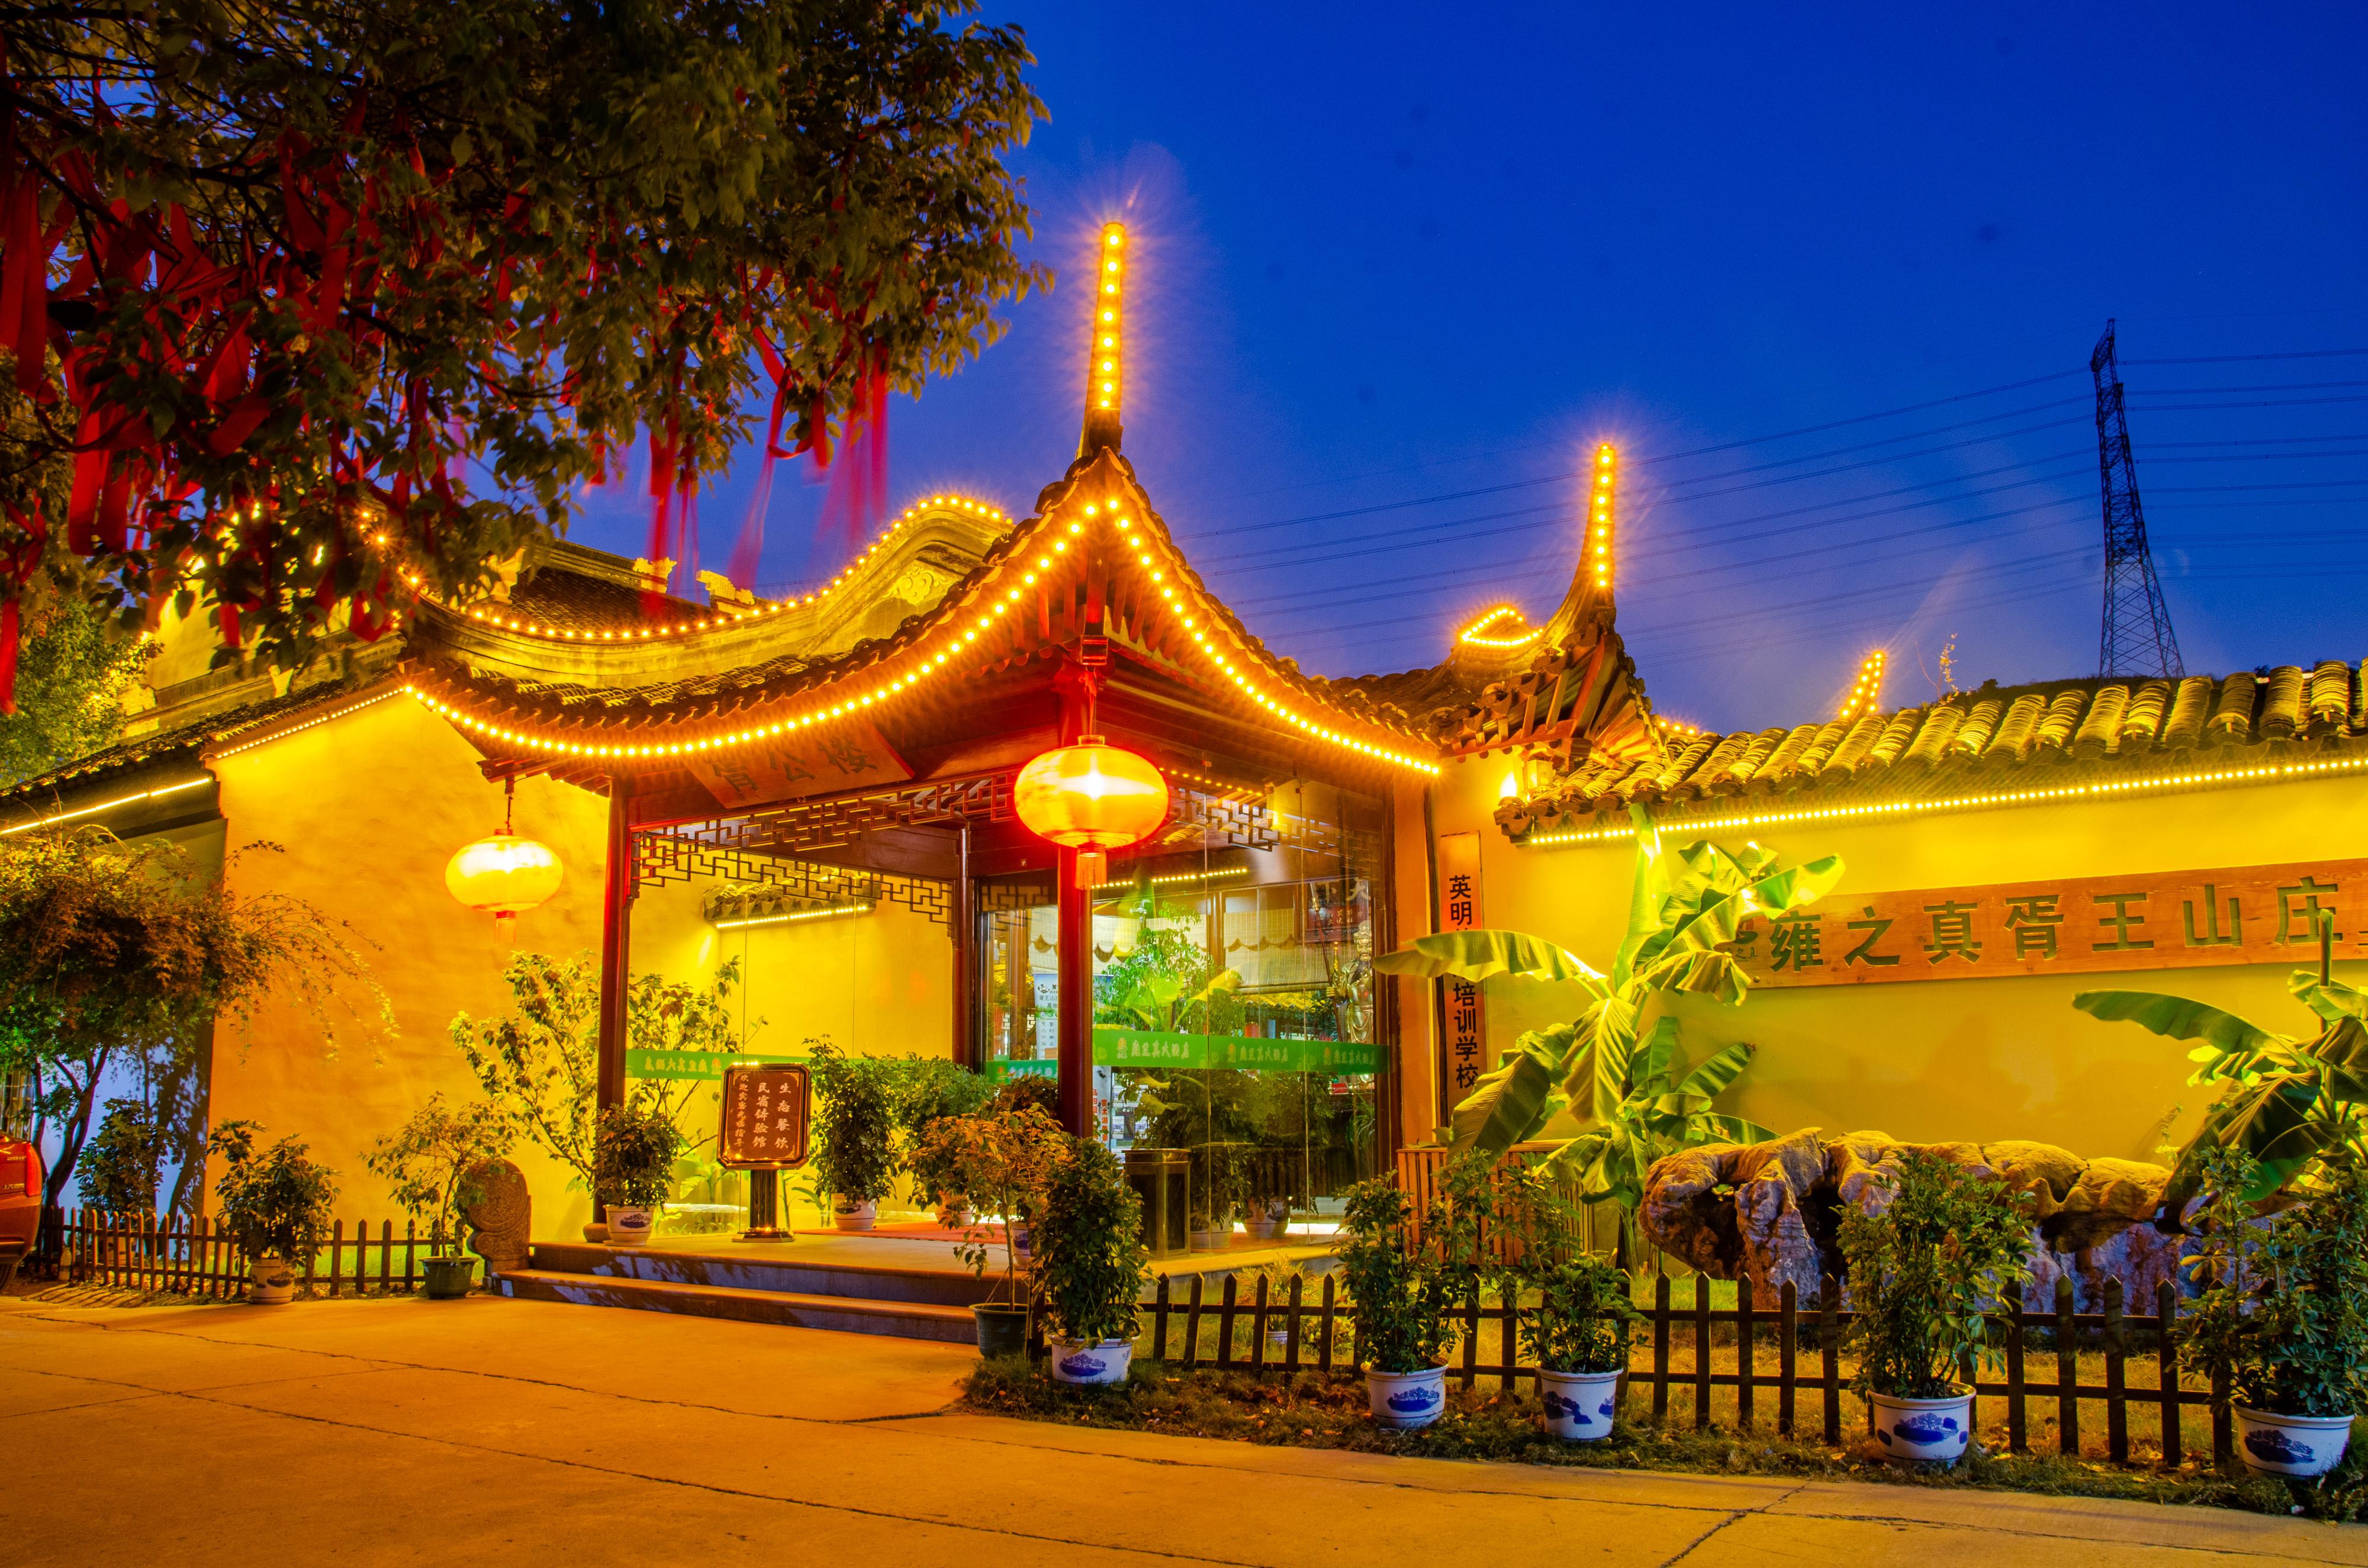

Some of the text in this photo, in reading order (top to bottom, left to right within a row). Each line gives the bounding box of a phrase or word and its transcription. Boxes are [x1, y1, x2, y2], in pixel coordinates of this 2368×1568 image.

[1769, 876, 2343, 972] 雍之真胥王山庄
[1449, 874, 1479, 1089] 英明培训学校
[752, 1082, 770, 1148] 民宿体验馆
[774, 1083, 792, 1149] 生态餐饮
